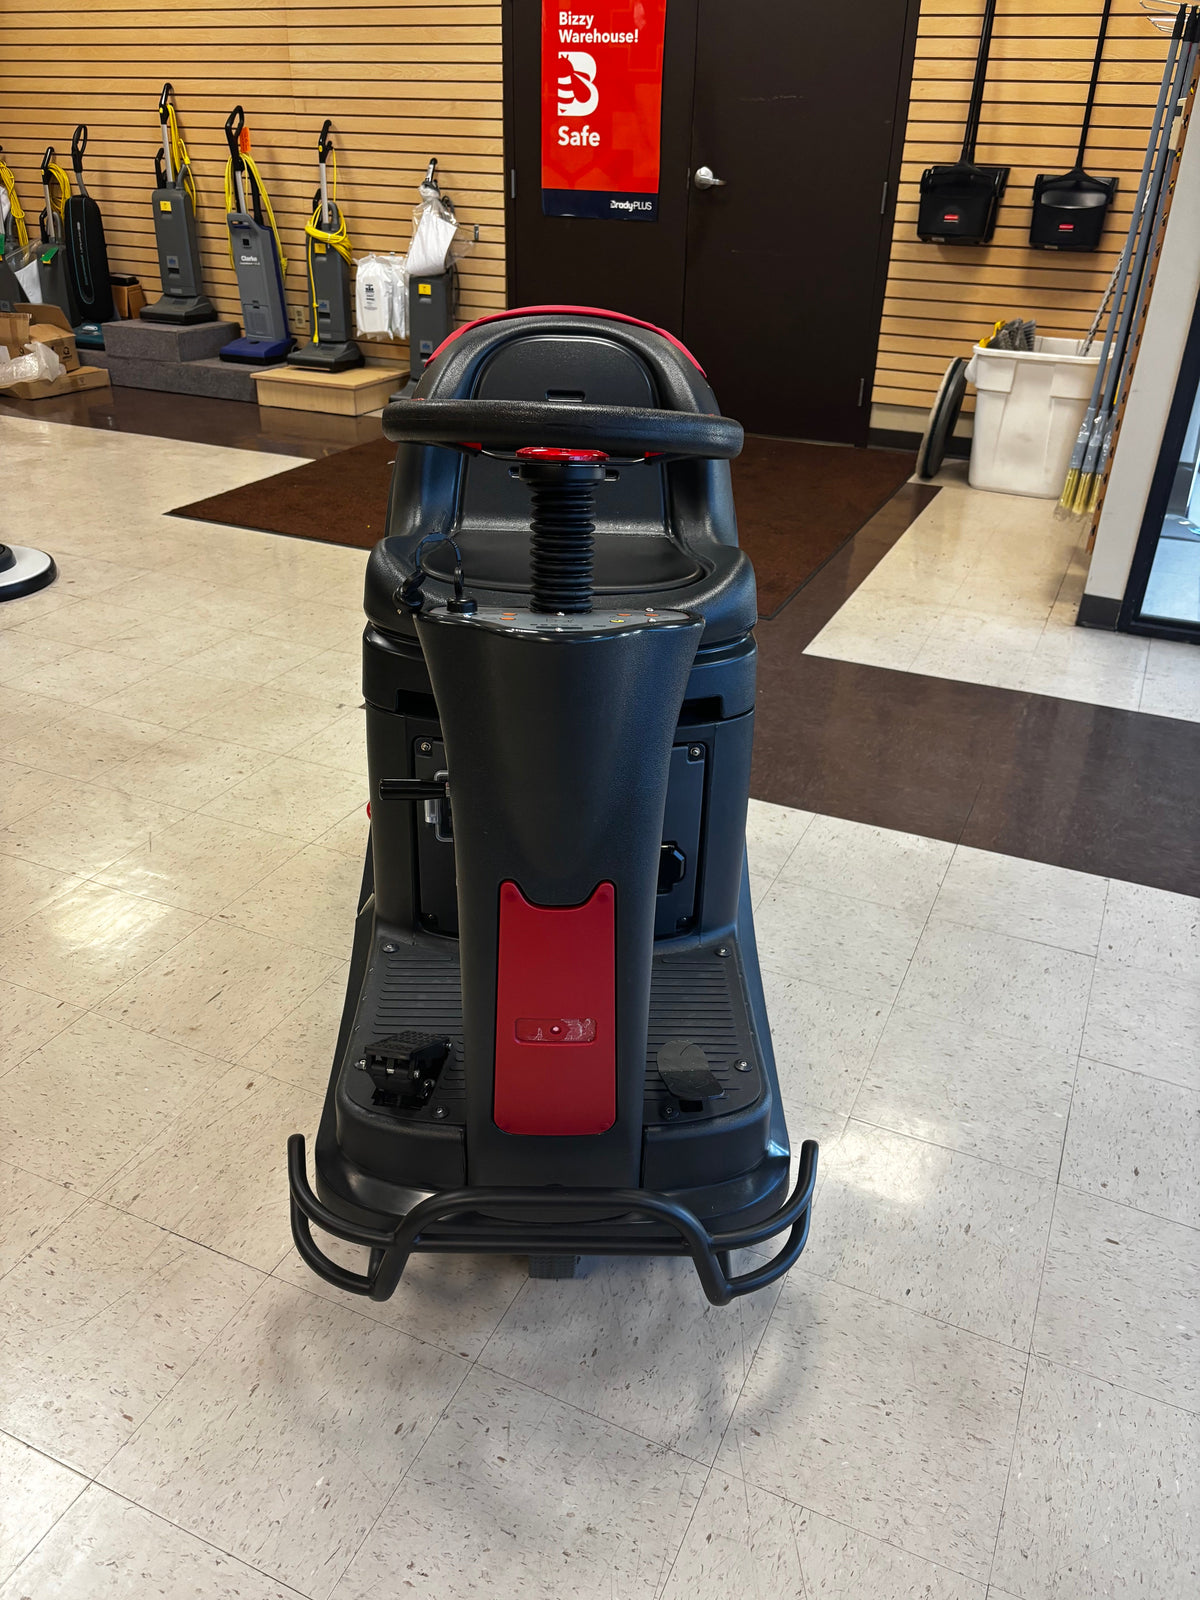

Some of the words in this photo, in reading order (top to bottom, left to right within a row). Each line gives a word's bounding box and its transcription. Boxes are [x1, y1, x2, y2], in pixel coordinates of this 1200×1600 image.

[559, 11, 594, 29] Bizzy
[559, 28, 639, 43] Warehouse!
[557, 125, 600, 146] Safe
